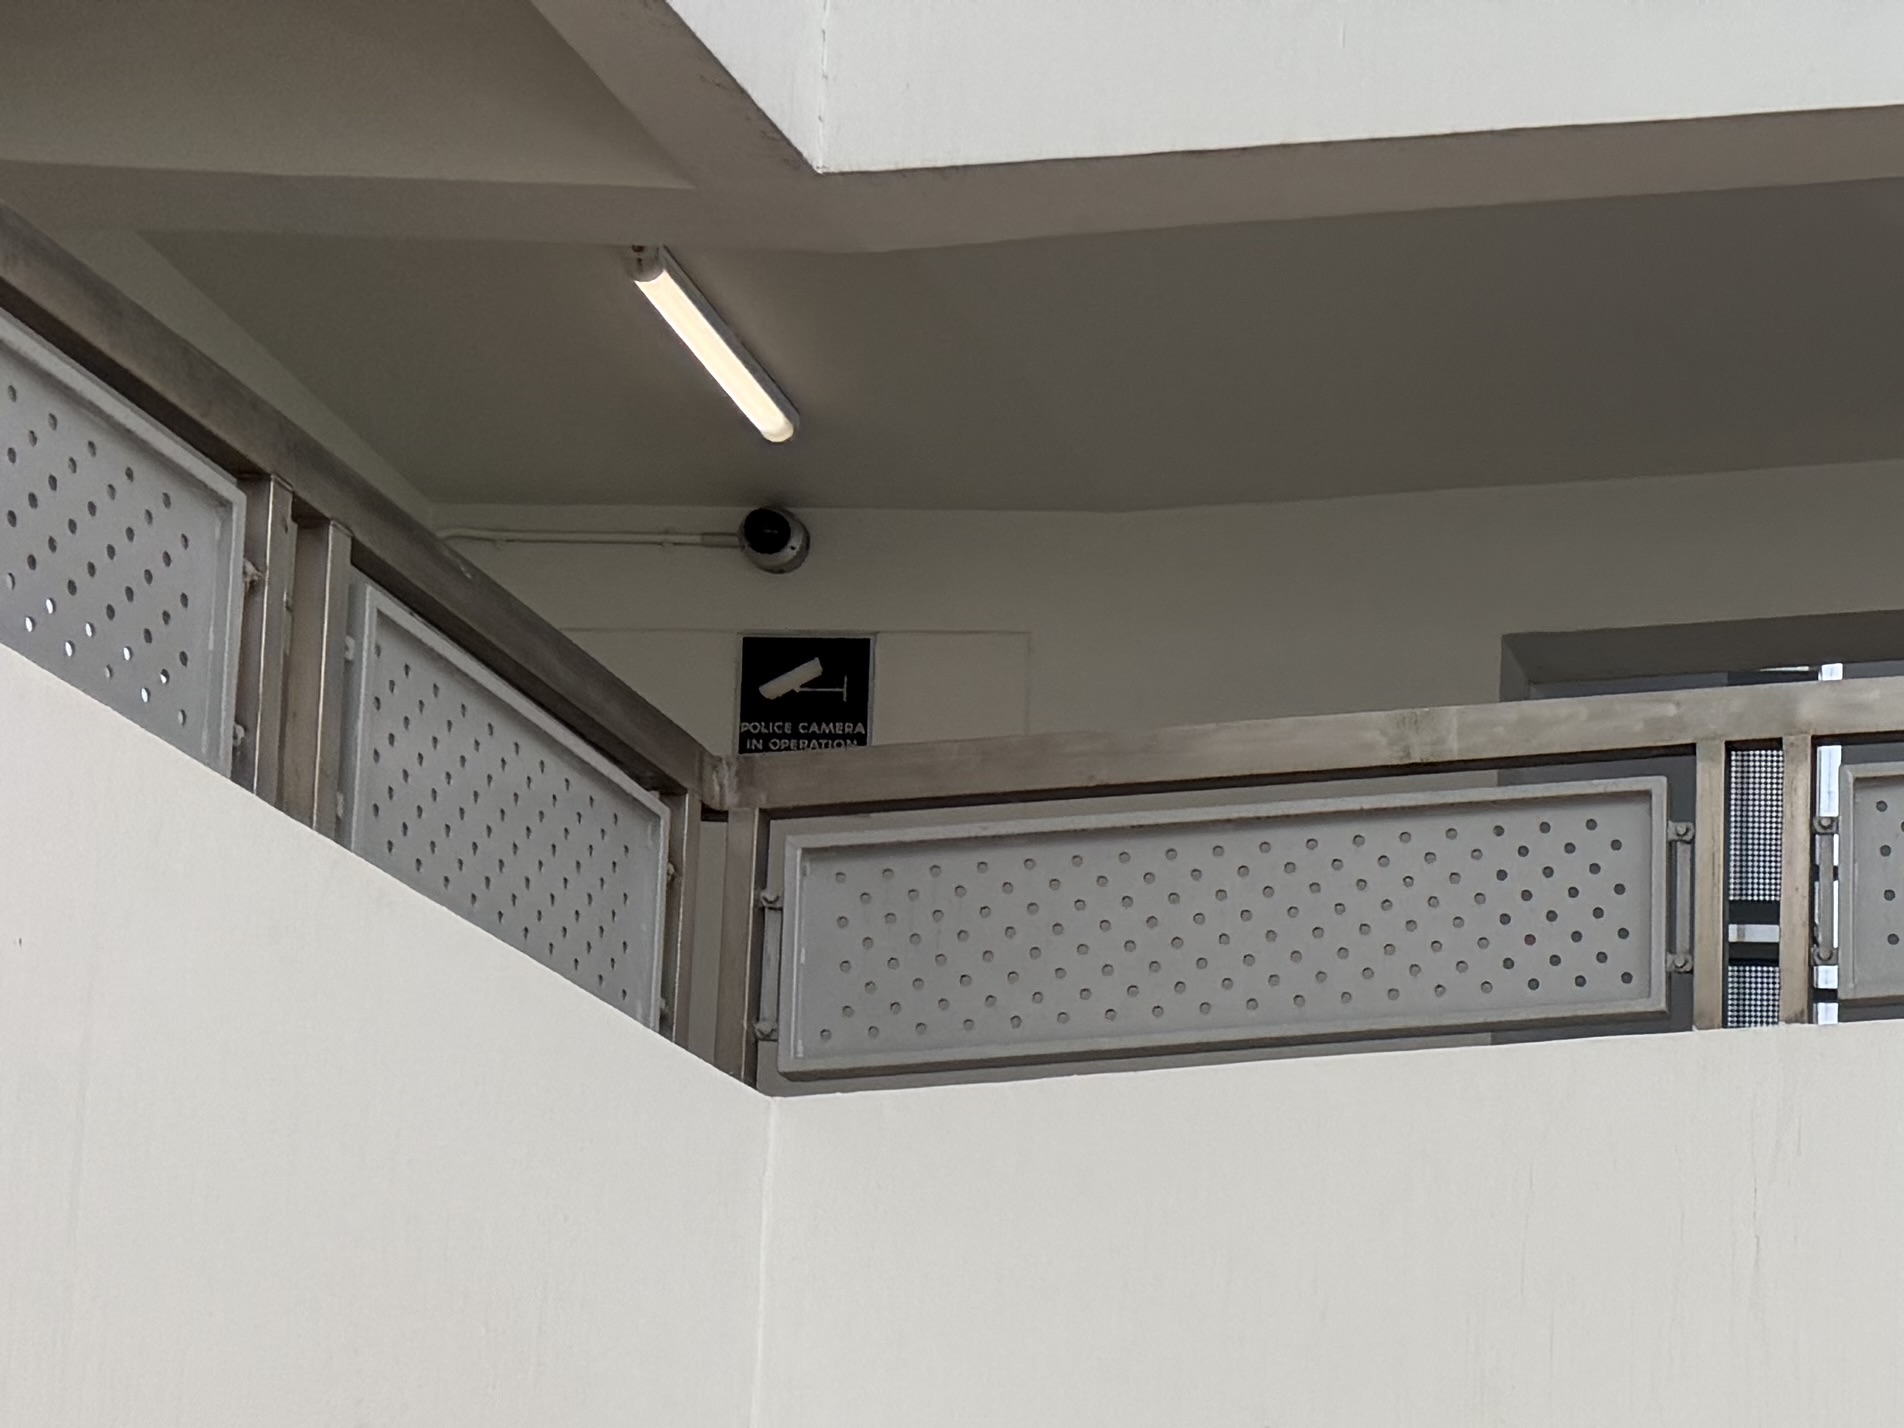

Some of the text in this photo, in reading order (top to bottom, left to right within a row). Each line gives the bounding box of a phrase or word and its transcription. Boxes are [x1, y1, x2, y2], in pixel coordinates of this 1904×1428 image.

[740, 721, 866, 735] POLICE CAMERA
[746, 738, 858, 751] IN OPERATION
